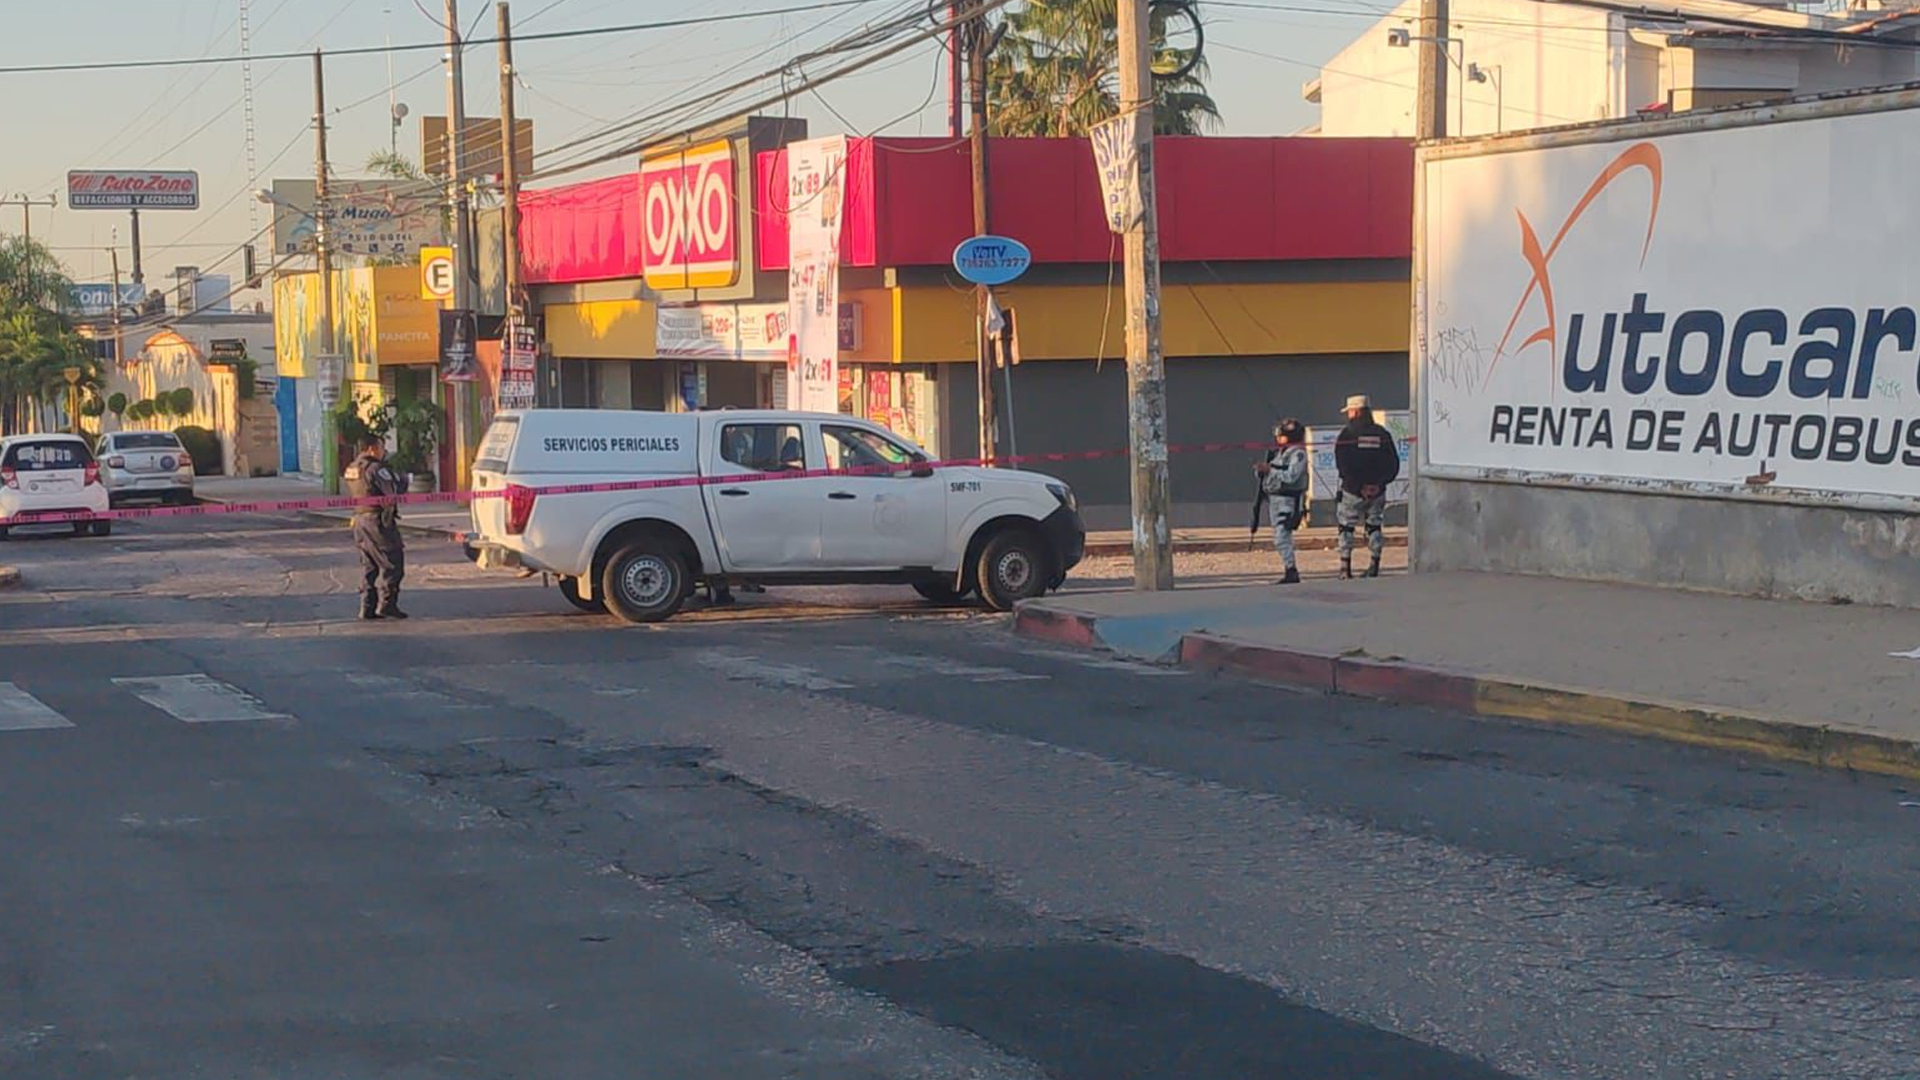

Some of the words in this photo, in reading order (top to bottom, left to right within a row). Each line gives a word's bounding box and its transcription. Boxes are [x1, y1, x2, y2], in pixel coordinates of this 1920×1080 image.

[102, 174, 191, 190] AutoZone
[646, 163, 728, 266] OXXO
[432, 264, 450, 289] E
[1490, 405, 1613, 449] RENTA
[1626, 409, 1686, 451] DE
[543, 438, 608, 452] SERVICIOS
[611, 438, 680, 452] PERICIALES
